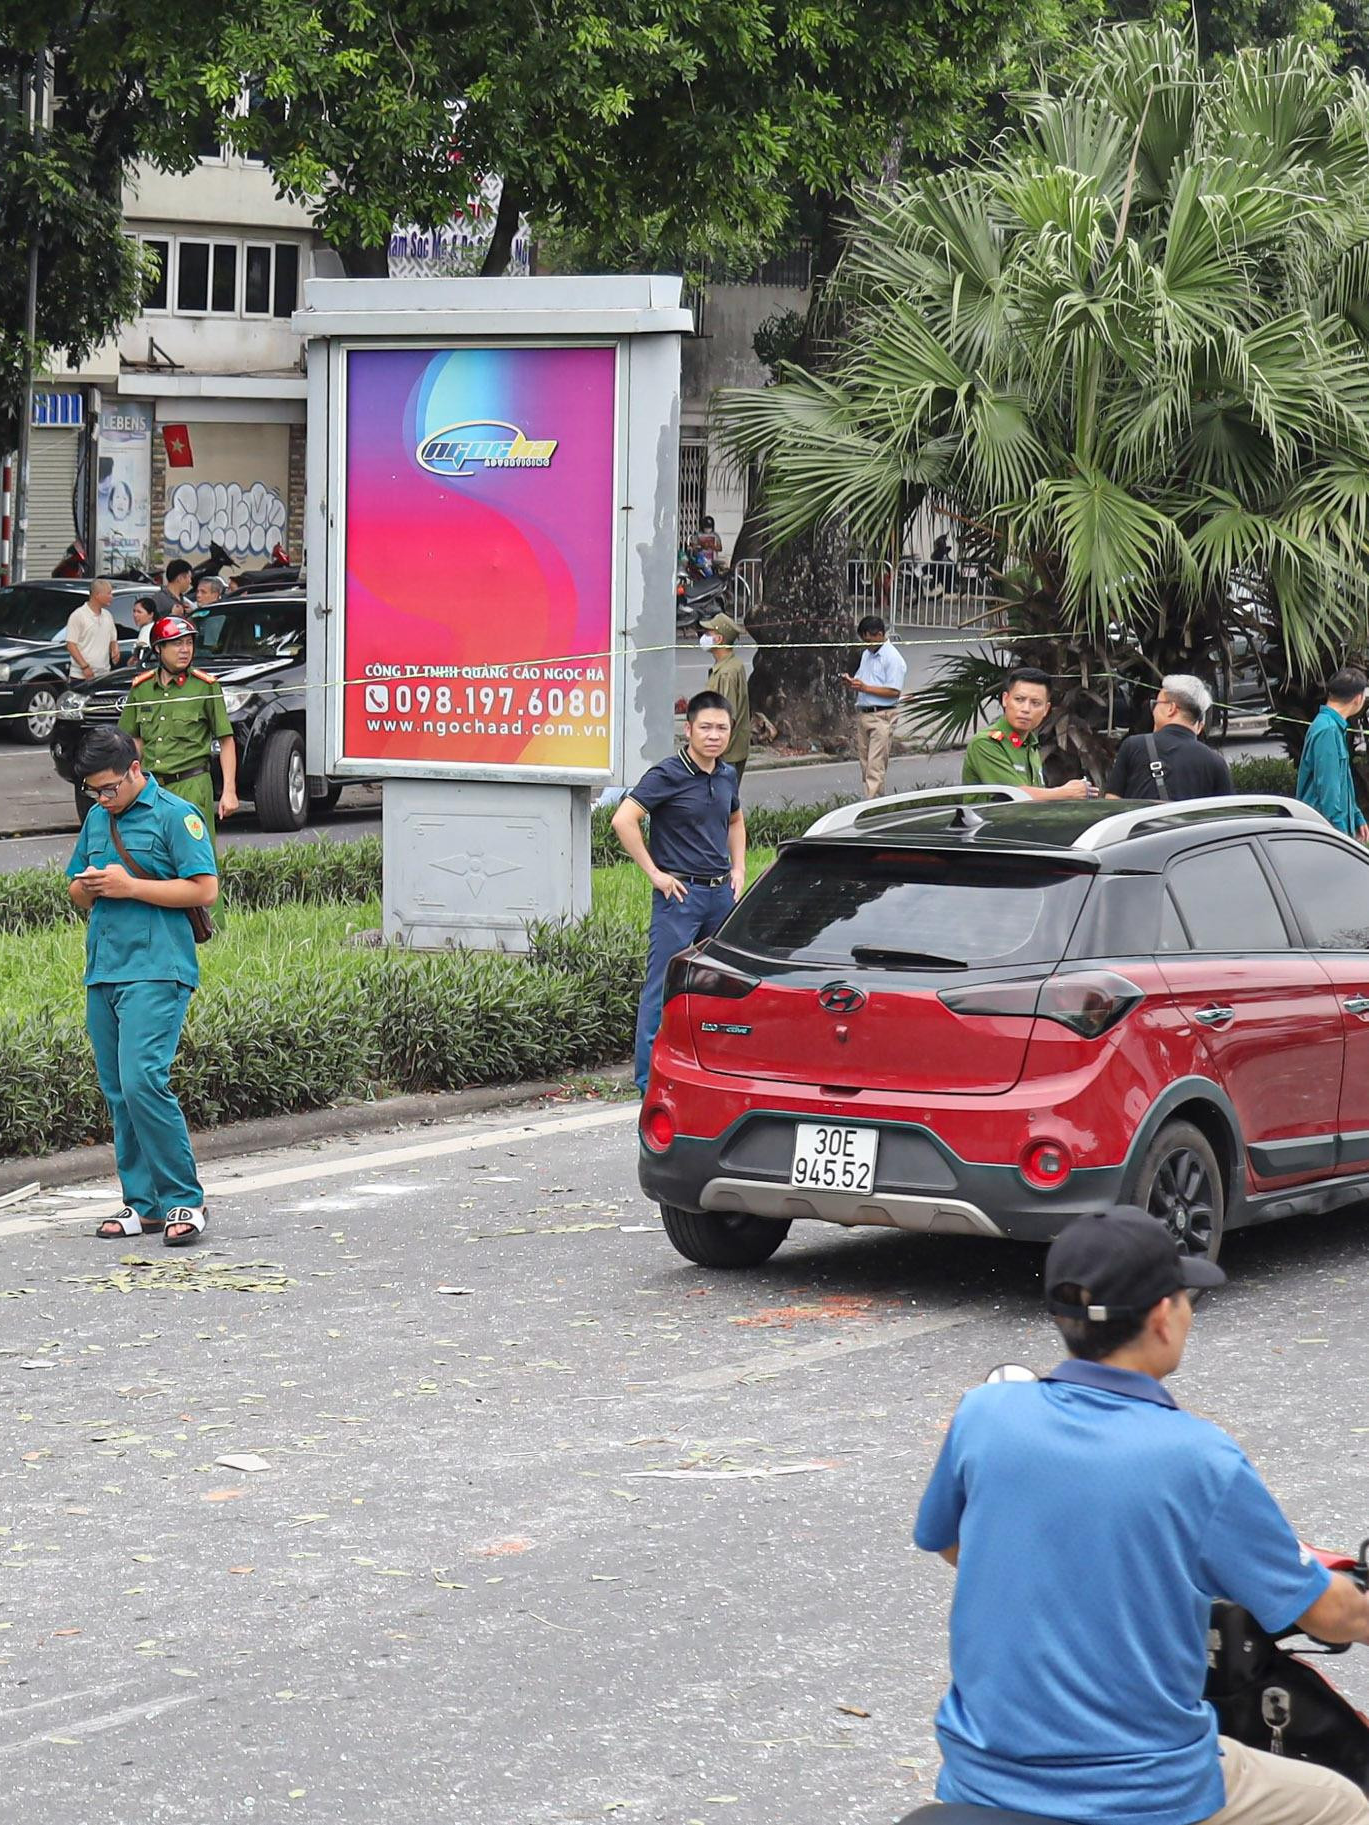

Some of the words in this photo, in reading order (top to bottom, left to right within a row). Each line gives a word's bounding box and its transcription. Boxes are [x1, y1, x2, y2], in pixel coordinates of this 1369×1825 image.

[102, 415, 146, 431] LEBENS
[365, 662, 401, 677] CÔNG
[404, 664, 420, 677] TY
[423, 665, 459, 678] TNHH
[461, 662, 509, 680] QUẢNG
[512, 664, 540, 679] CÁO
[543, 667, 583, 682] NGỌC
[586, 666, 605, 681] HÀ
[395, 685, 606, 717] 098.197.6080
[367, 718, 606, 736] www.ngochaad.com.vn
[814, 1128, 857, 1157] 30E
[794, 1157, 870, 1189] 945.52
